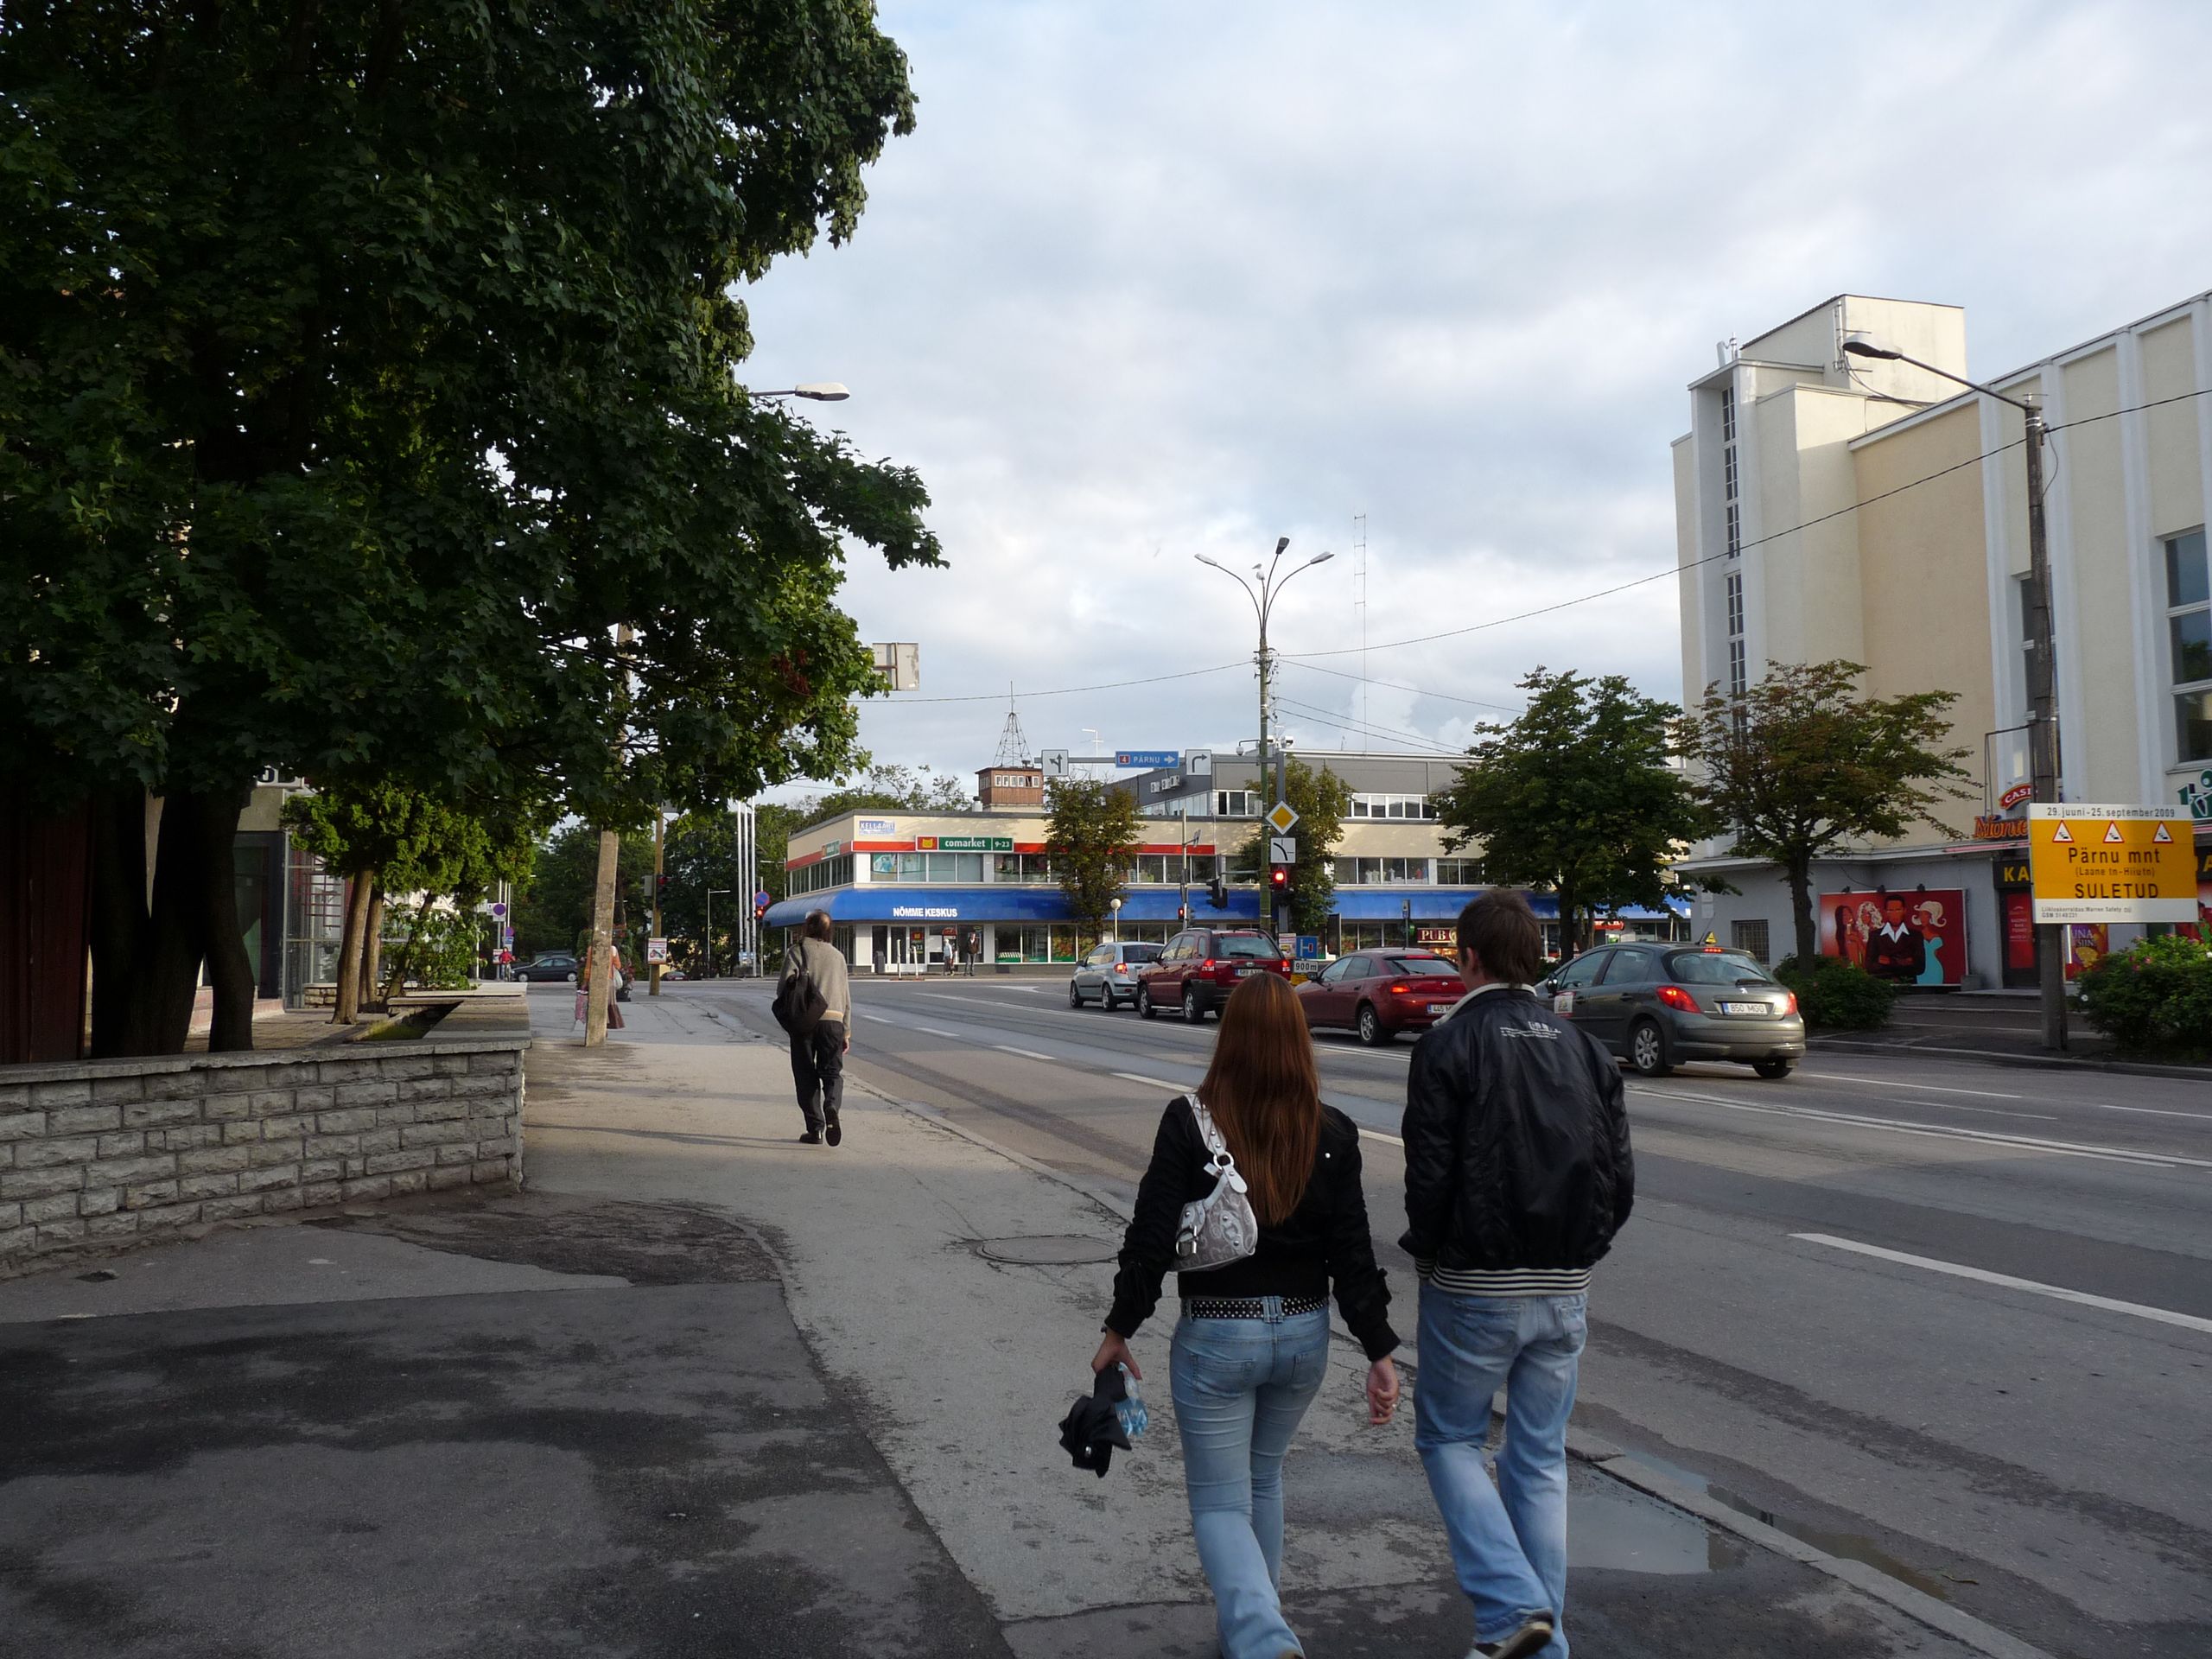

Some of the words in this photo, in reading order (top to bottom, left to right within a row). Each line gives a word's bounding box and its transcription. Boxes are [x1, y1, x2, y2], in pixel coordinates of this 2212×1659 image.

[1133, 755, 1160, 764] PÄRNU
[2005, 787, 2031, 804] CASI
[944, 839, 986, 848] comarket
[2069, 847, 2120, 864] Pärnu
[2128, 849, 2160, 864] mnt
[2075, 883, 2159, 899] SULETUD
[893, 906, 924, 917] NÕMME
[925, 907, 958, 918] KESKUS
[1421, 930, 1446, 941] PUB
